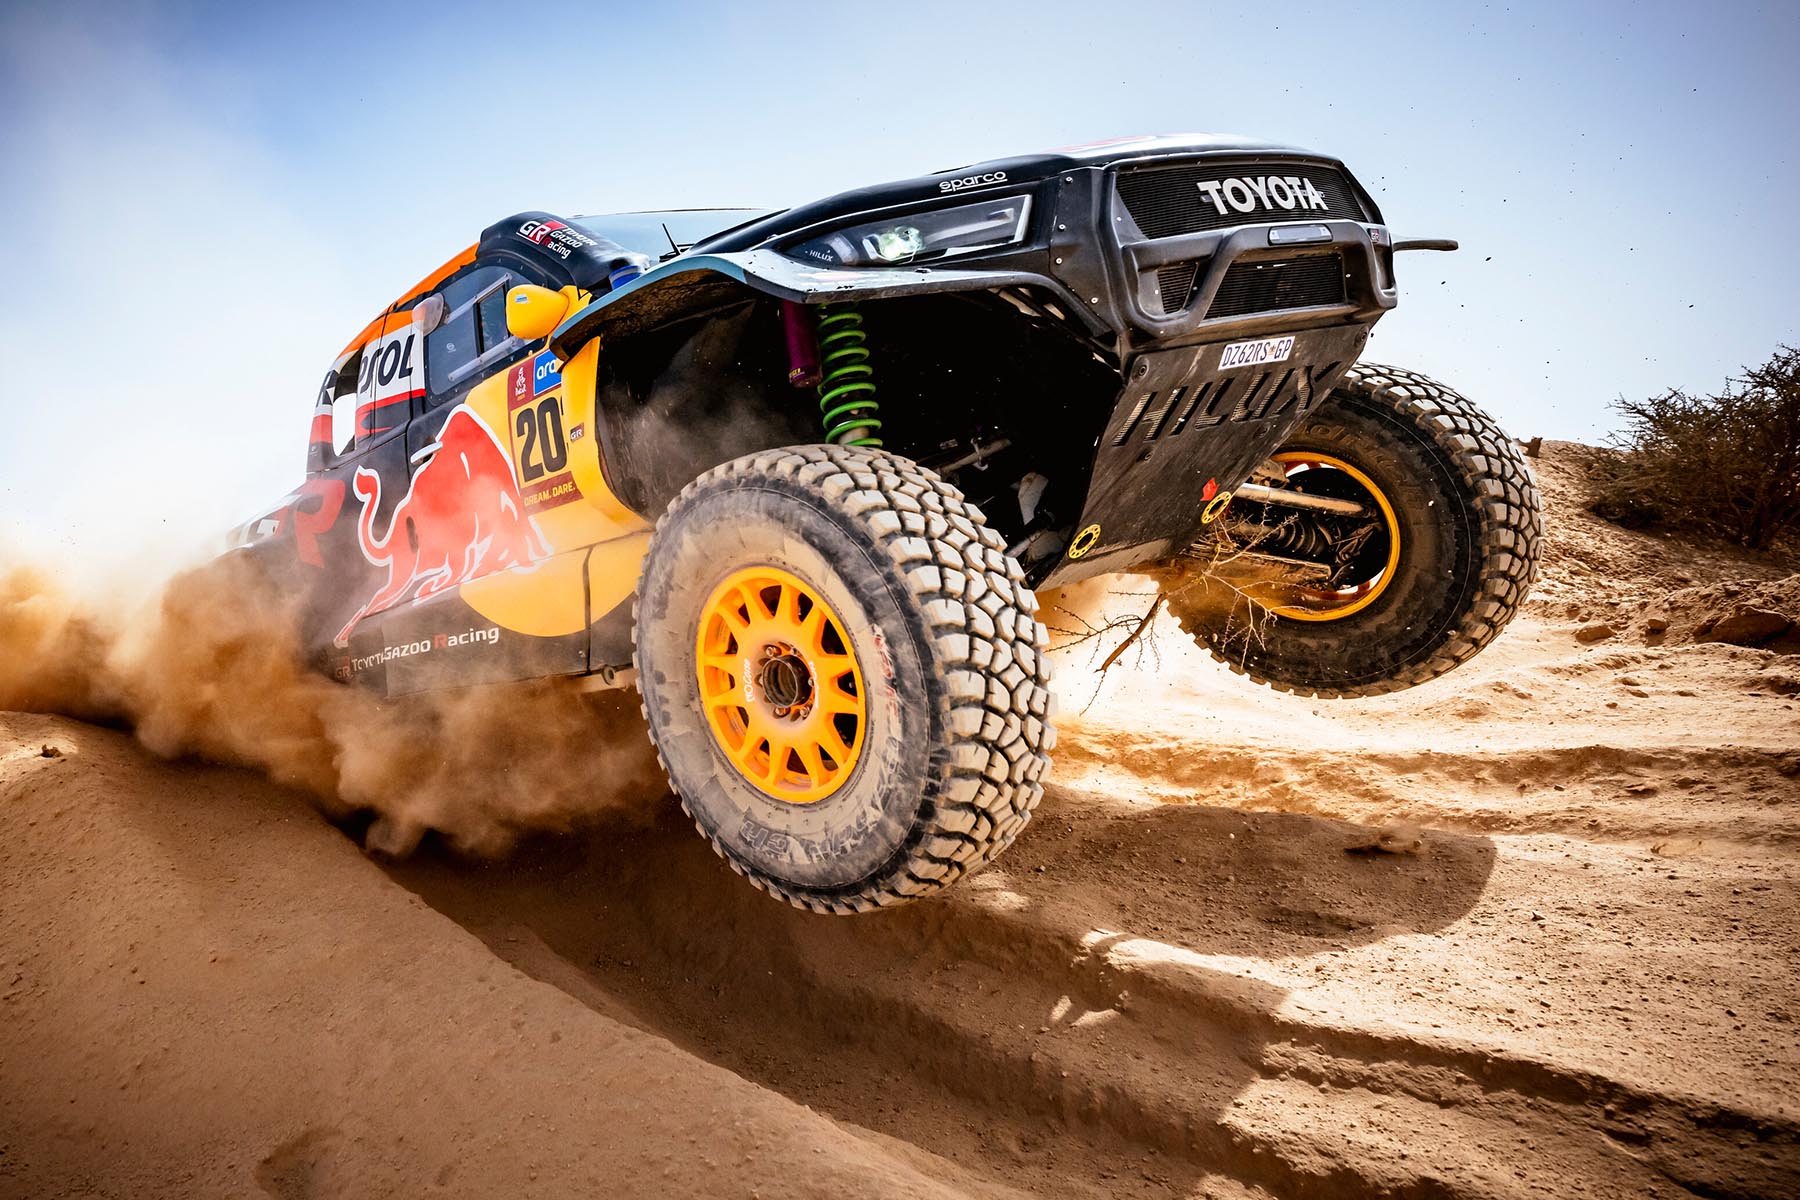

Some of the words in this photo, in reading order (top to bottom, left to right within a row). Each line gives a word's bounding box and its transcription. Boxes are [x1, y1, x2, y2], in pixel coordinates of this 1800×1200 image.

[939, 171, 1007, 192] sparco
[1197, 175, 1329, 215] TOYOTA
[519, 220, 552, 242] GR
[549, 230, 584, 248] GAZOO
[561, 227, 599, 246] TOYOTA
[541, 236, 572, 260] Racing
[809, 249, 834, 262] HILUX
[1273, 339, 1292, 360] GP
[1112, 360, 1342, 447] HILUX
[570, 428, 583, 440] GR
[524, 489, 552, 507] DREAM.
[552, 481, 576, 498] DARE.
[384, 639, 431, 661] GAZOO
[434, 627, 500, 649] Racing
